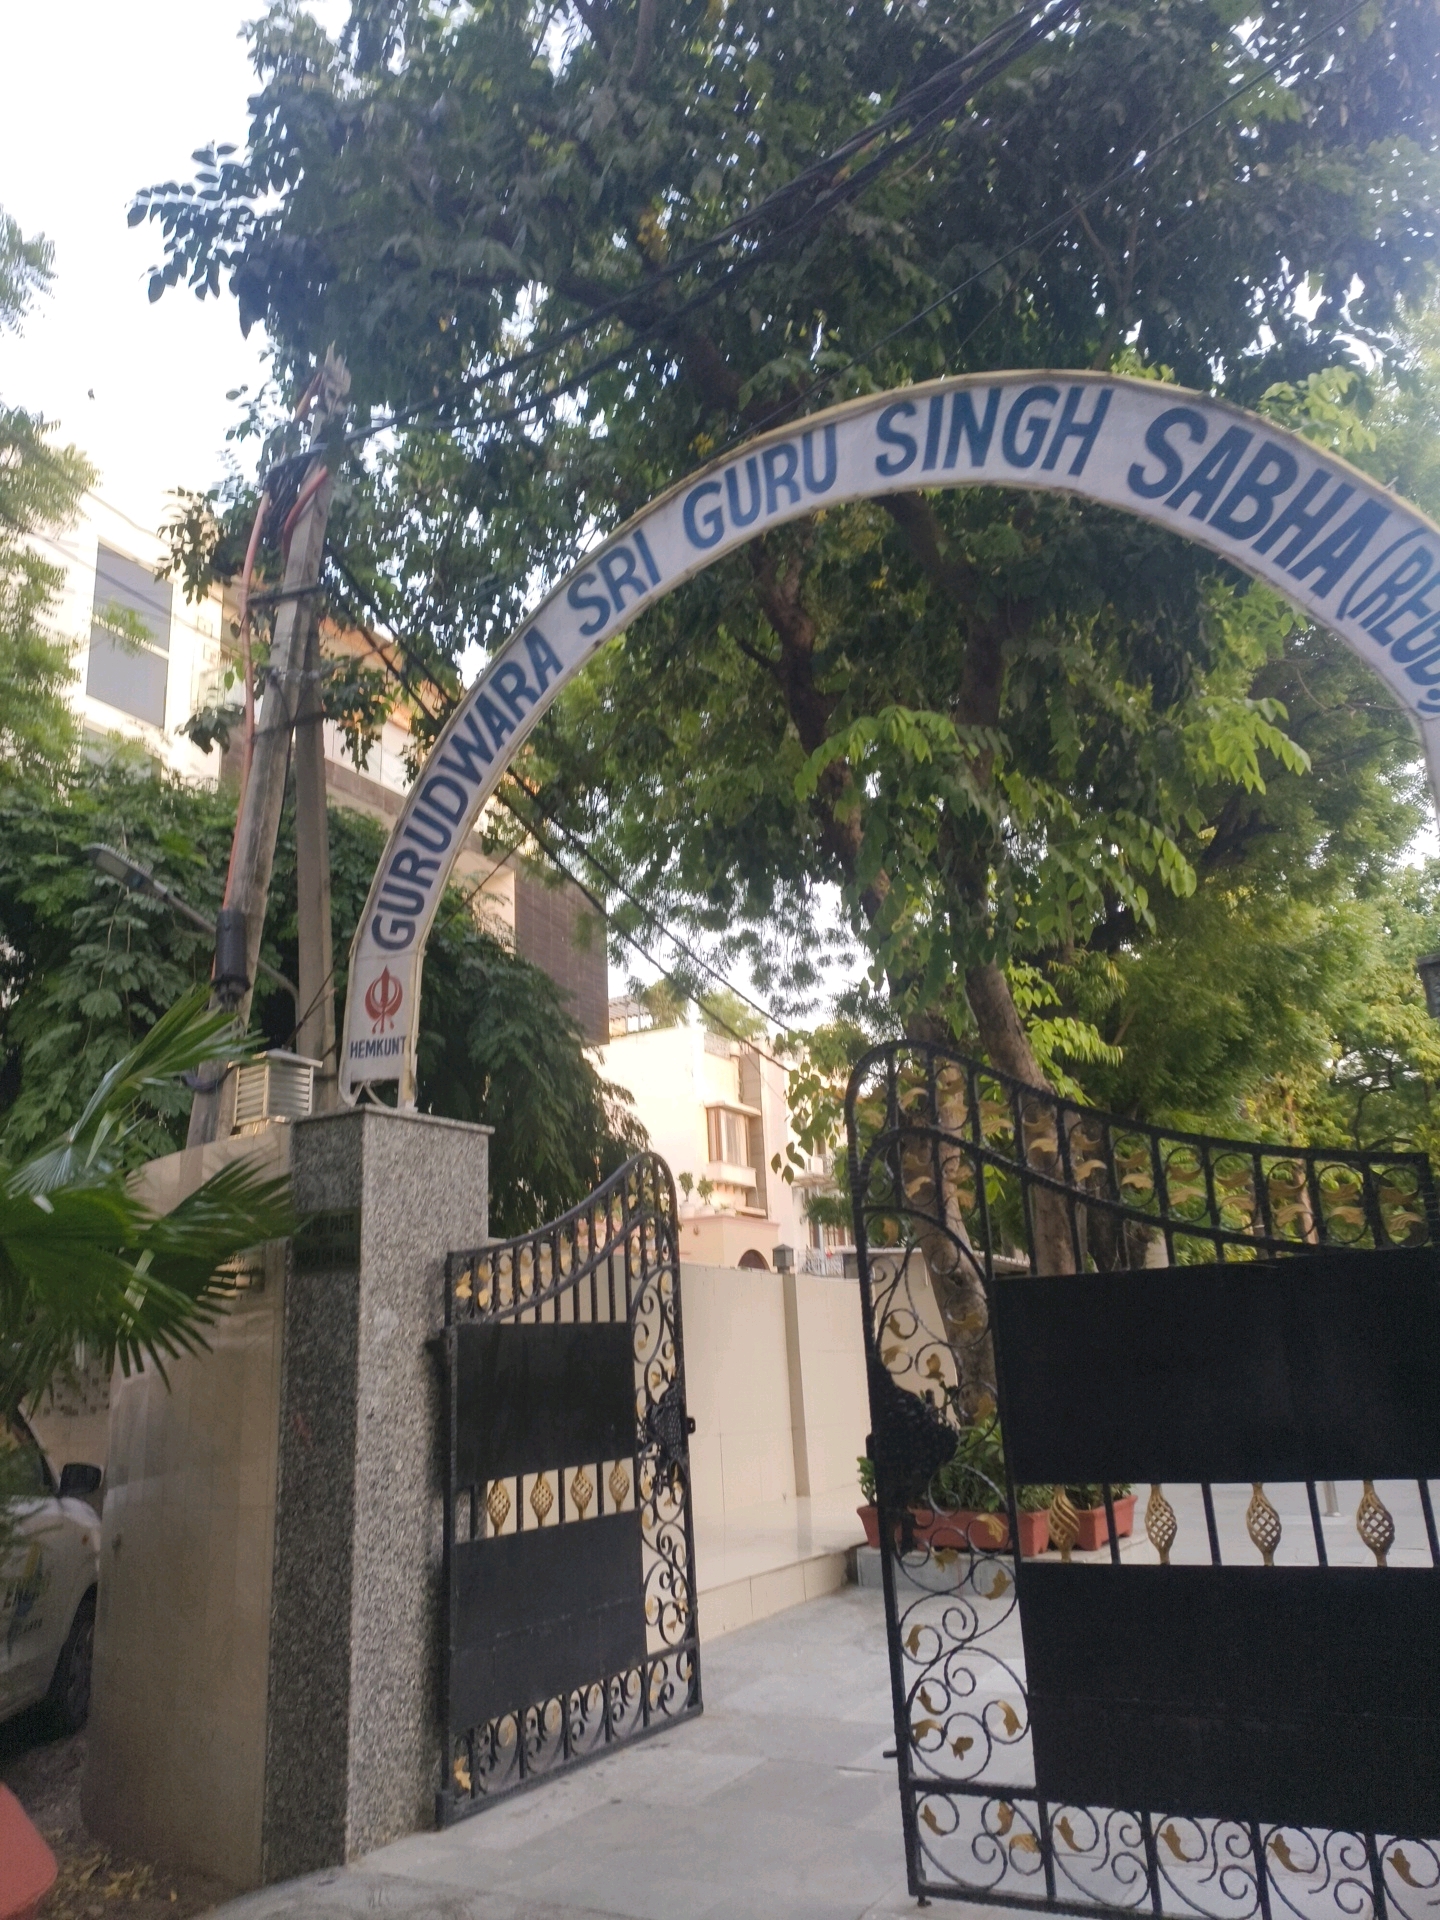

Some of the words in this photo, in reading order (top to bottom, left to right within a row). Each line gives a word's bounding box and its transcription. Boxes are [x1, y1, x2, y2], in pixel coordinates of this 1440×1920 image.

[371, 626, 564, 950] GURUDWARA
[567, 528, 661, 636] SRI
[682, 423, 838, 550] GURU
[876, 384, 1115, 477] SINGH
[350, 1035, 406, 1059] HEMKUNT
[330, 1213, 354, 1232] PASTE
